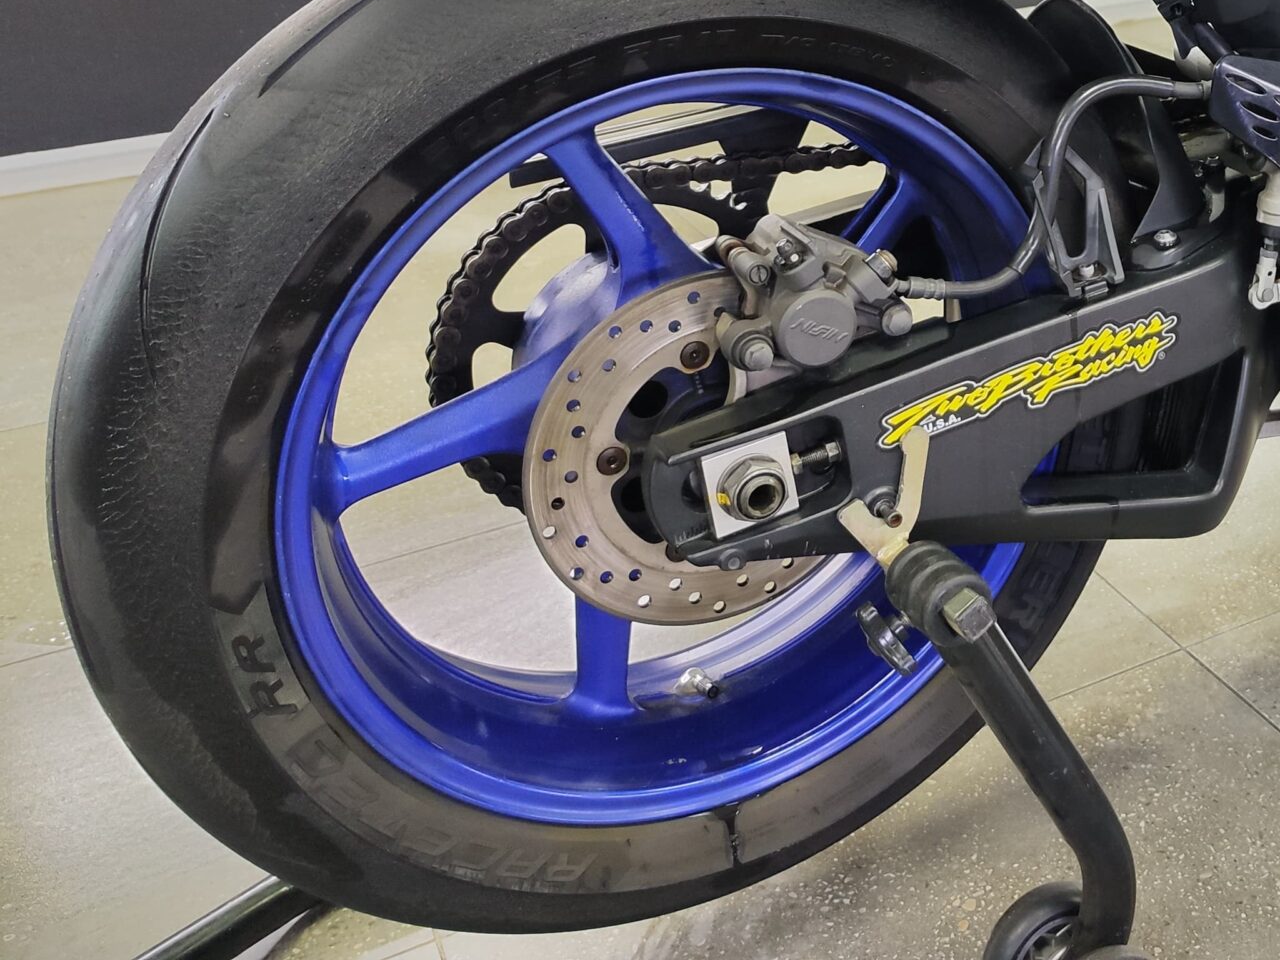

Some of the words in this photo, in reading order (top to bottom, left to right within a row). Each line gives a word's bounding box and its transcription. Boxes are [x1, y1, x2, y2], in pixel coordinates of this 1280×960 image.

[882, 386, 993, 445] Two
[978, 314, 1177, 413] Brothers
[1027, 334, 1175, 404] Racing
